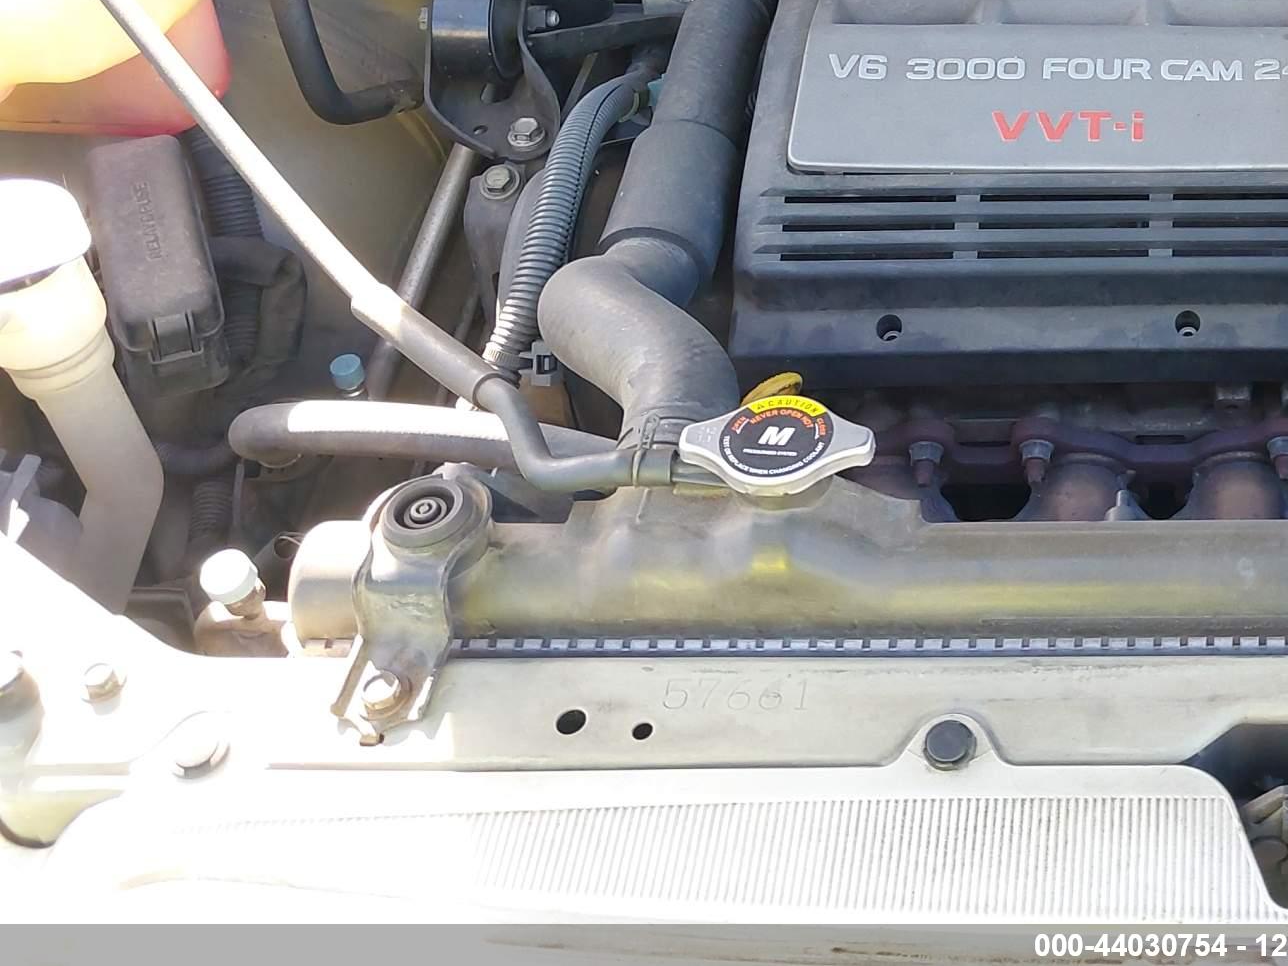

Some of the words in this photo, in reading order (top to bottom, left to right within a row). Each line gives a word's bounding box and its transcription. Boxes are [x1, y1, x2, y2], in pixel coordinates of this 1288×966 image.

[828, 54, 887, 80] V6
[905, 55, 1026, 80] 3000
[1042, 57, 1152, 81] FOUR
[1160, 58, 1243, 82] CAM
[992, 110, 1145, 143] VVT-i
[768, 399, 820, 414] CAUTION
[749, 409, 779, 425] NEVER
[779, 409, 804, 420] OPEN
[800, 416, 814, 429] HOT
[757, 426, 797, 446] M
